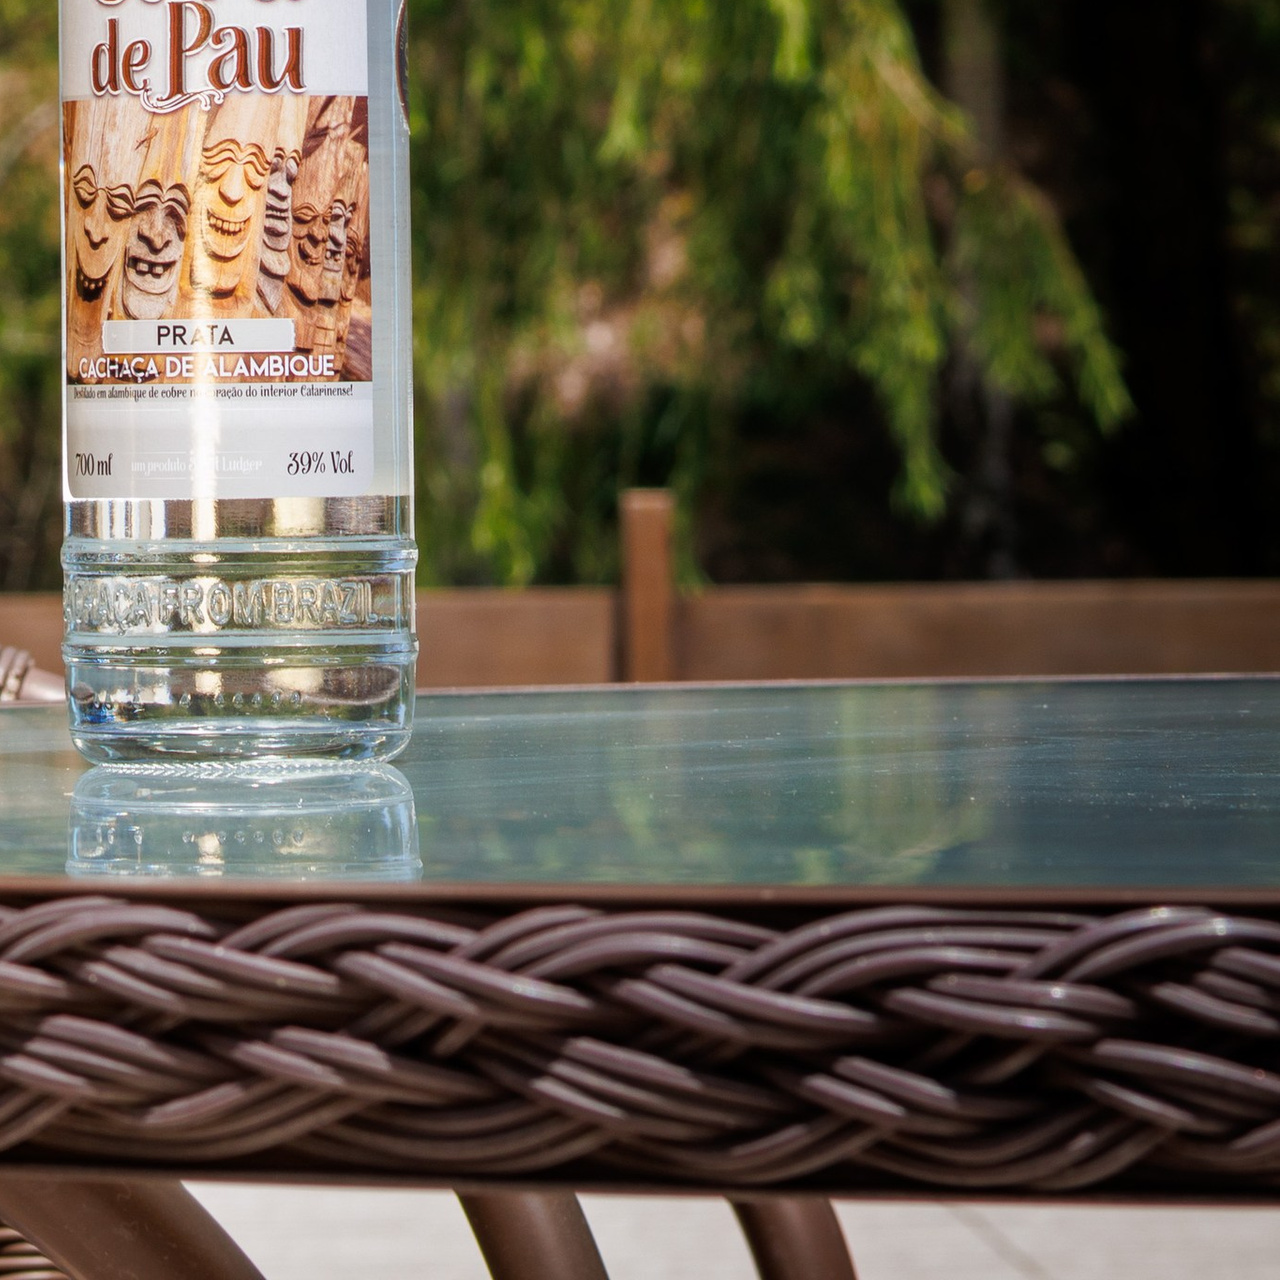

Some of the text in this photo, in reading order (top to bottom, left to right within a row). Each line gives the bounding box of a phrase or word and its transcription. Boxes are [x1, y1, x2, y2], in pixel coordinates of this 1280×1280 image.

[91, 17, 151, 96] de
[160, 0, 307, 108] Pau
[156, 324, 235, 346] PRATA
[79, 354, 335, 384] CACHAÇA DE ALAMBIQUE
[96, 389, 107, 399] em
[108, 386, 146, 403] alambique
[148, 386, 159, 398] de
[161, 386, 187, 398] cobre
[205, 387, 243, 399] ração
[245, 385, 258, 398] do
[260, 384, 298, 397] interior
[300, 384, 353, 397] Catarinense!
[75, 453, 95, 477] 700
[287, 450, 355, 476] 39% Vol.
[270, 580, 378, 625] BRAZIL
